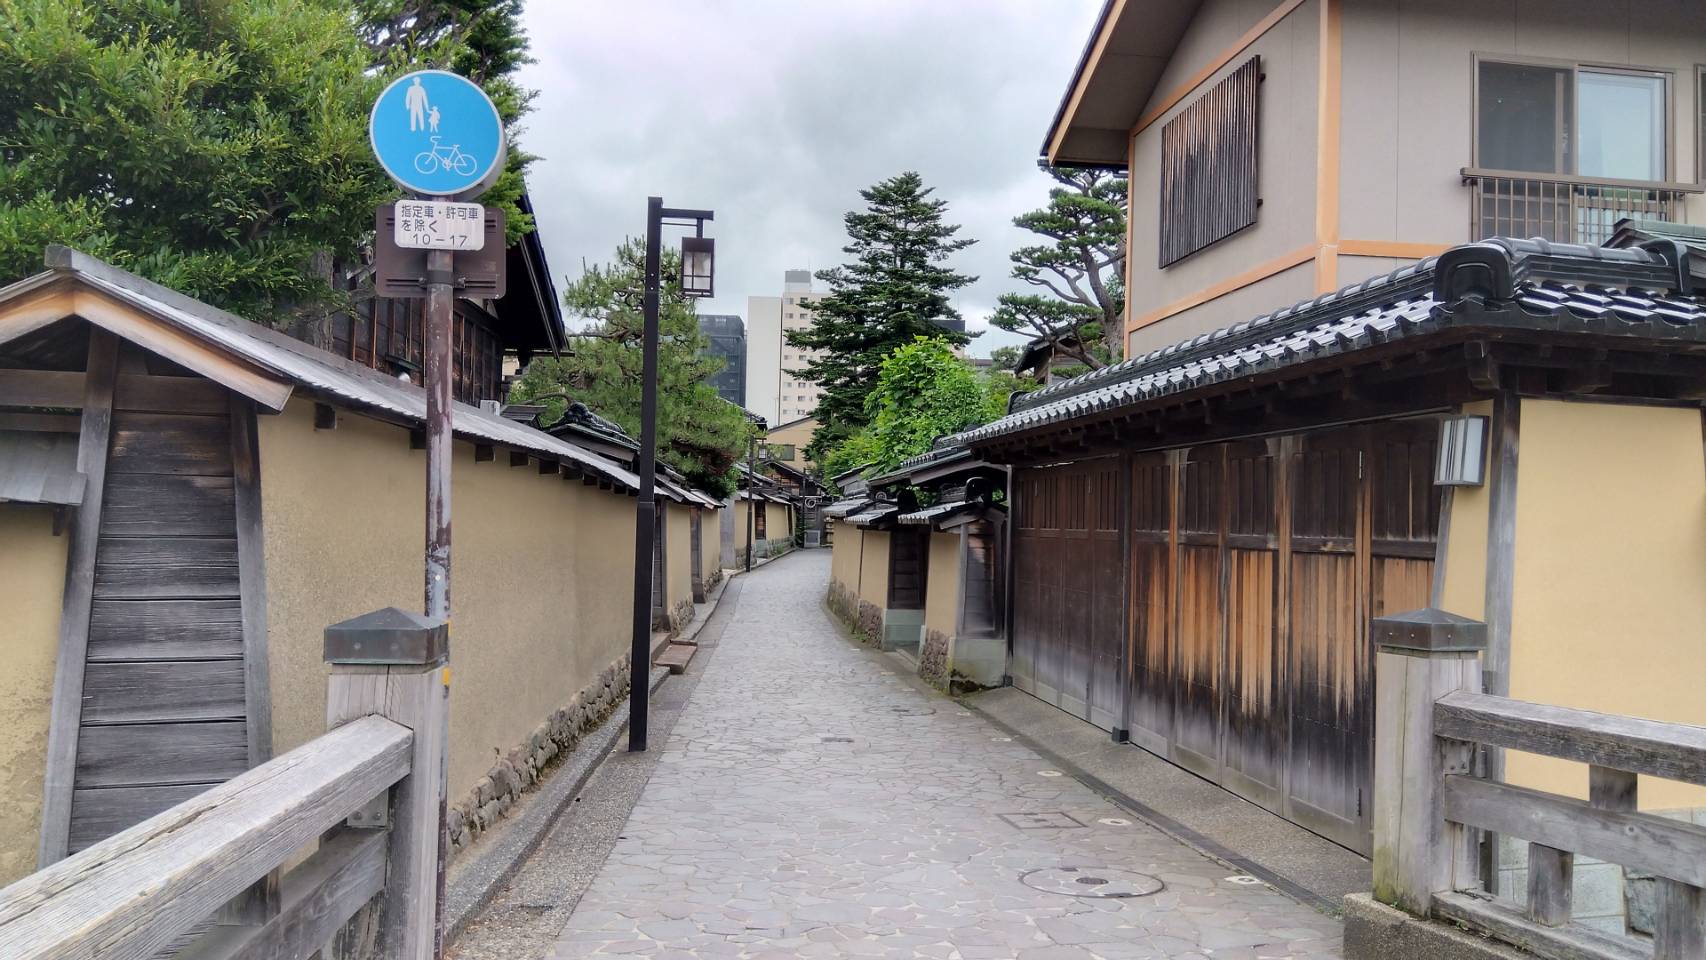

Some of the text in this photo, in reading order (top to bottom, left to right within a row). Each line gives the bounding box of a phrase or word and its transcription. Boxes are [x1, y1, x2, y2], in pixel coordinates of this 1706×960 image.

[401, 205, 479, 220] 指定車・許可車
[401, 219, 438, 233] を除く
